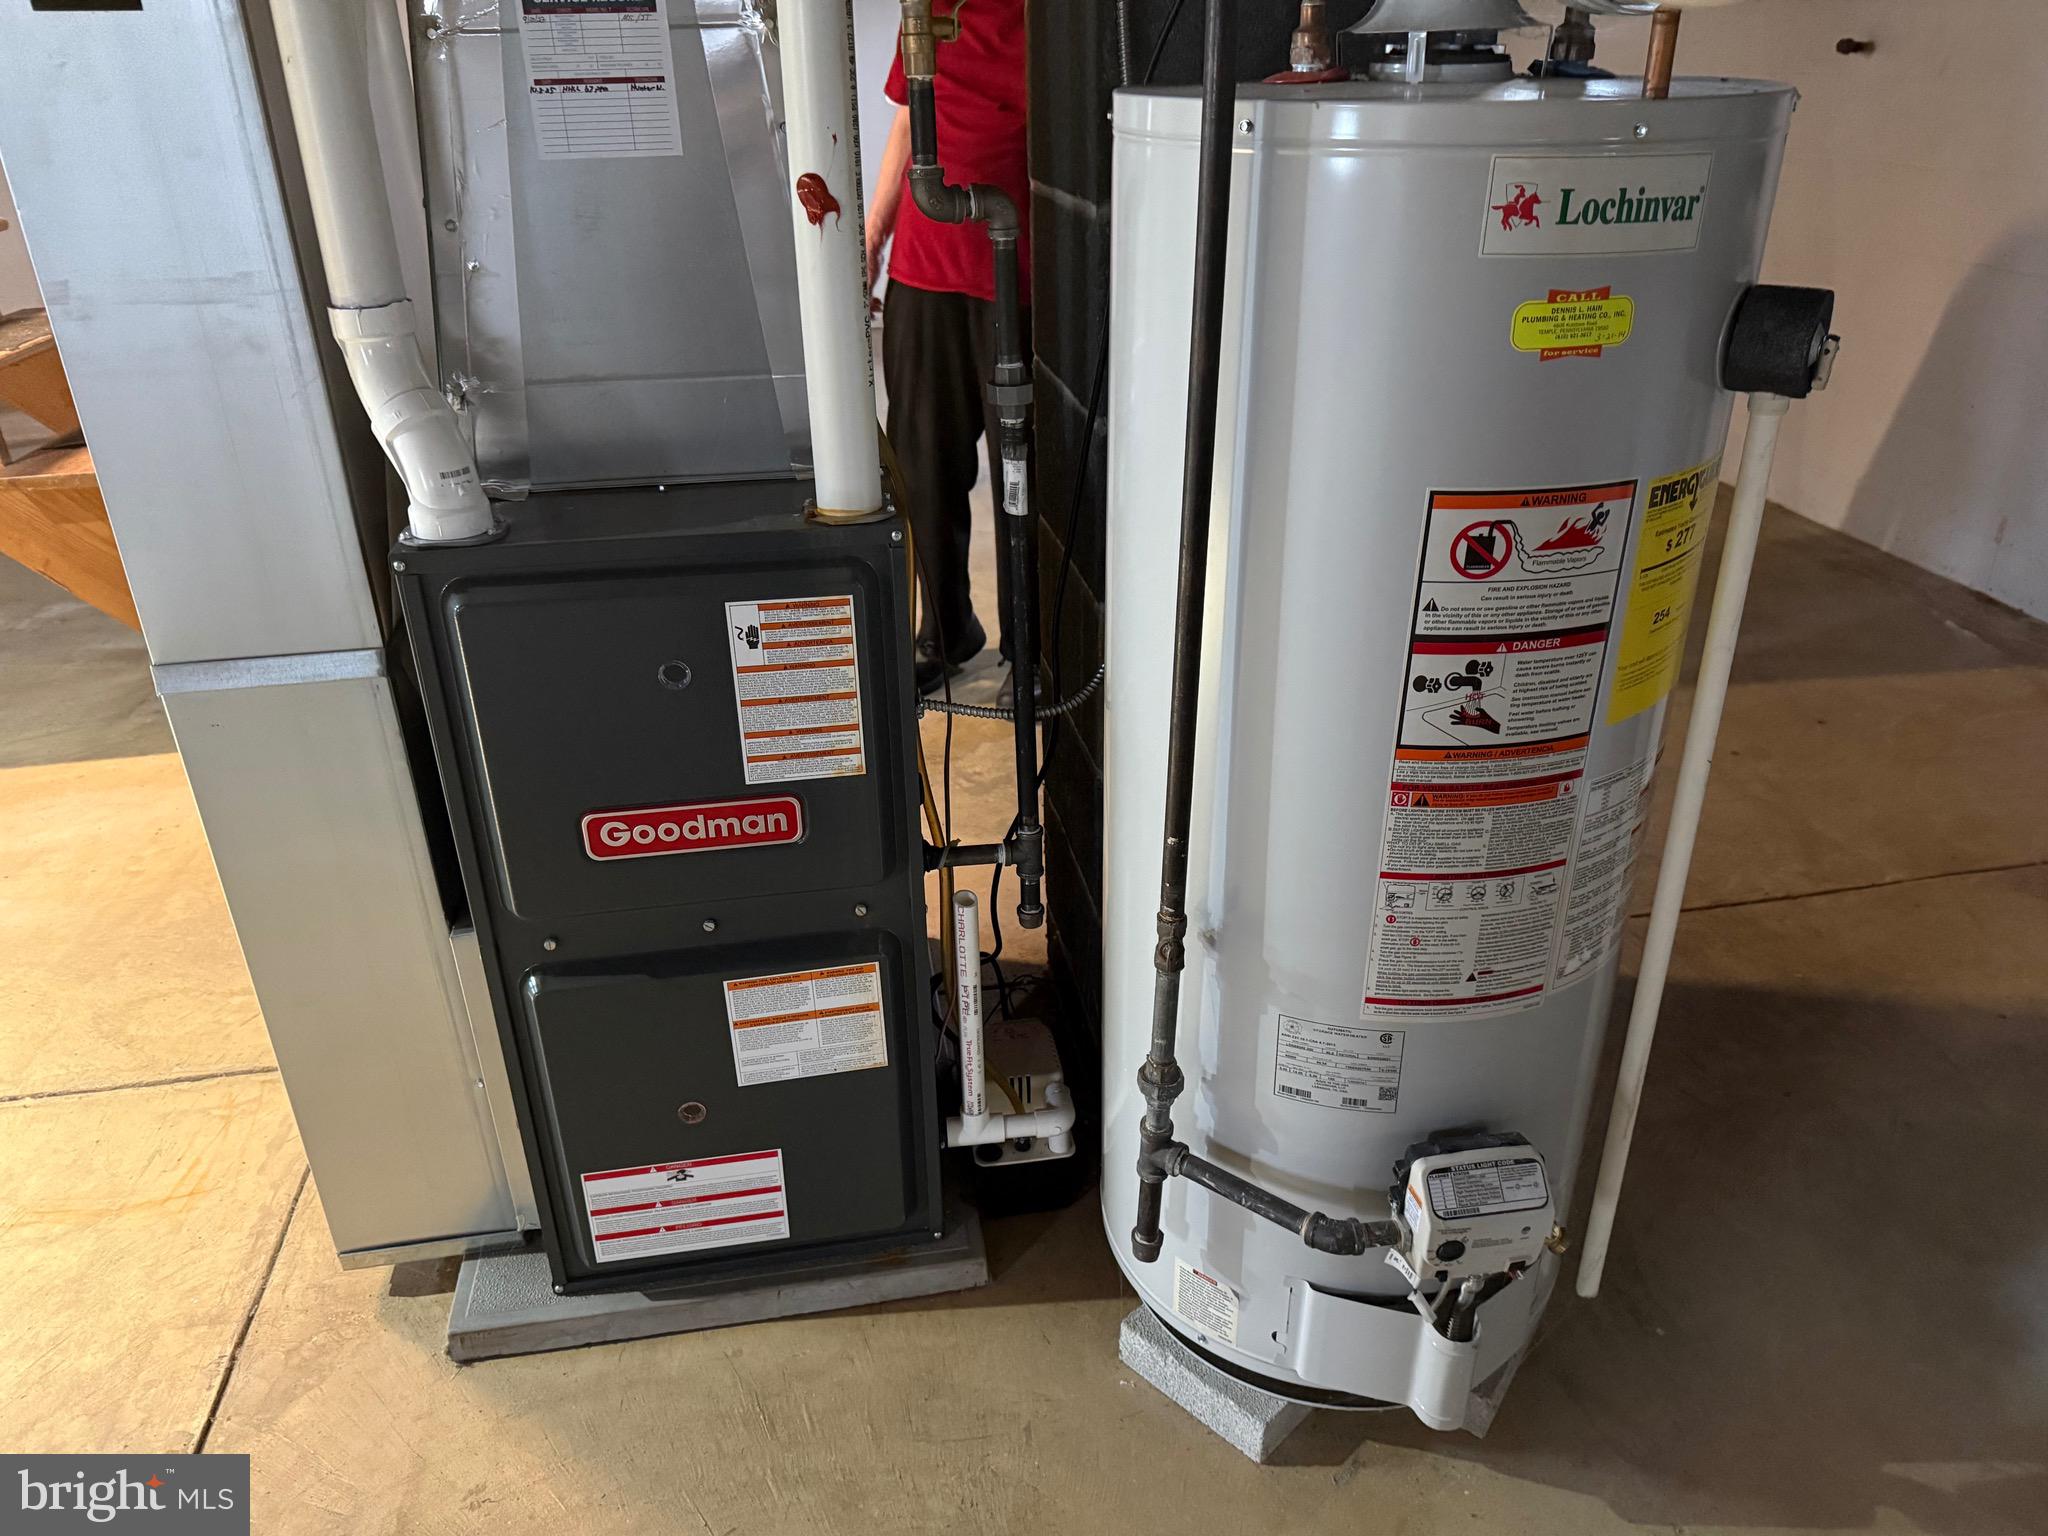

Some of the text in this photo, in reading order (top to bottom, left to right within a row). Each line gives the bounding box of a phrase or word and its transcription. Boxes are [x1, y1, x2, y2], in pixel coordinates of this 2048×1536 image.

[1555, 186, 1700, 226] Lochinvar
[1556, 292, 1601, 302] CALL
[1551, 306, 1577, 315] DENNIS
[1586, 304, 1603, 312] HAIN
[1522, 315, 1559, 323] PLUMBING
[1568, 312, 1597, 321] HEATING
[1561, 347, 1599, 356] service
[1531, 492, 1587, 506] WARNING
[1532, 555, 1587, 567] Flammable Vapors
[1549, 581, 1572, 589] HAZARD
[1442, 612, 1463, 620] vicinity
[1652, 605, 1671, 625] 254
[1478, 618, 1498, 626] vapors
[1512, 638, 1561, 650] DANGER
[1453, 751, 1493, 759] WARNING
[600, 812, 788, 847] Goodman
[957, 906, 968, 979] CHARLOTTE
[1451, 1159, 1515, 1171] STATUS LIGHT CODE
